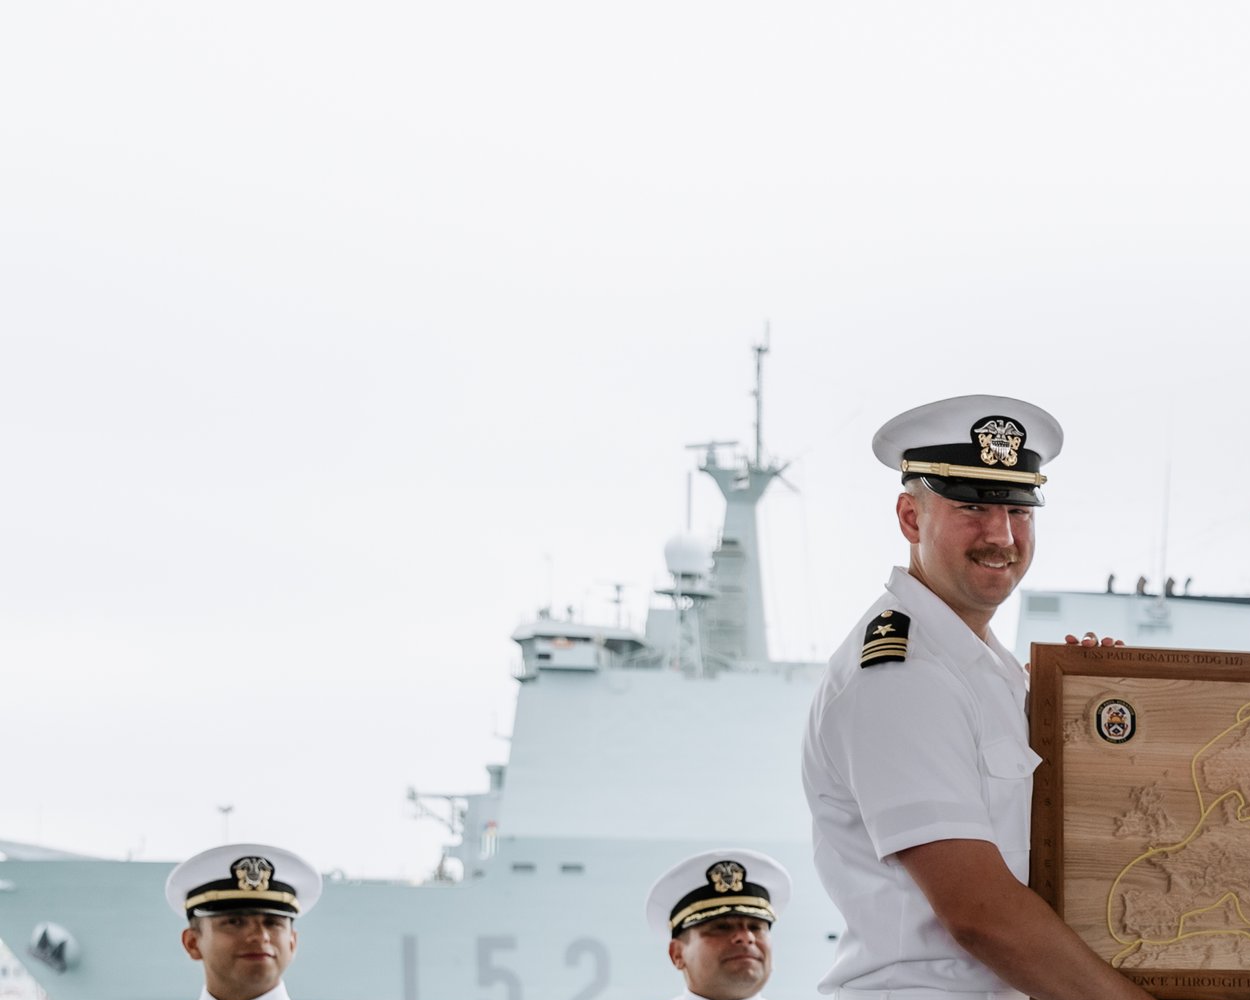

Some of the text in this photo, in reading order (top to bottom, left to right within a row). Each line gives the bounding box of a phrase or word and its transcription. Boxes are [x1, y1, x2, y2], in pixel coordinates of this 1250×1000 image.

[1082, 651, 1244, 666] USS PAUL IGNATIUS (DDG 117)
[1172, 976, 1241, 988] THROUGH
